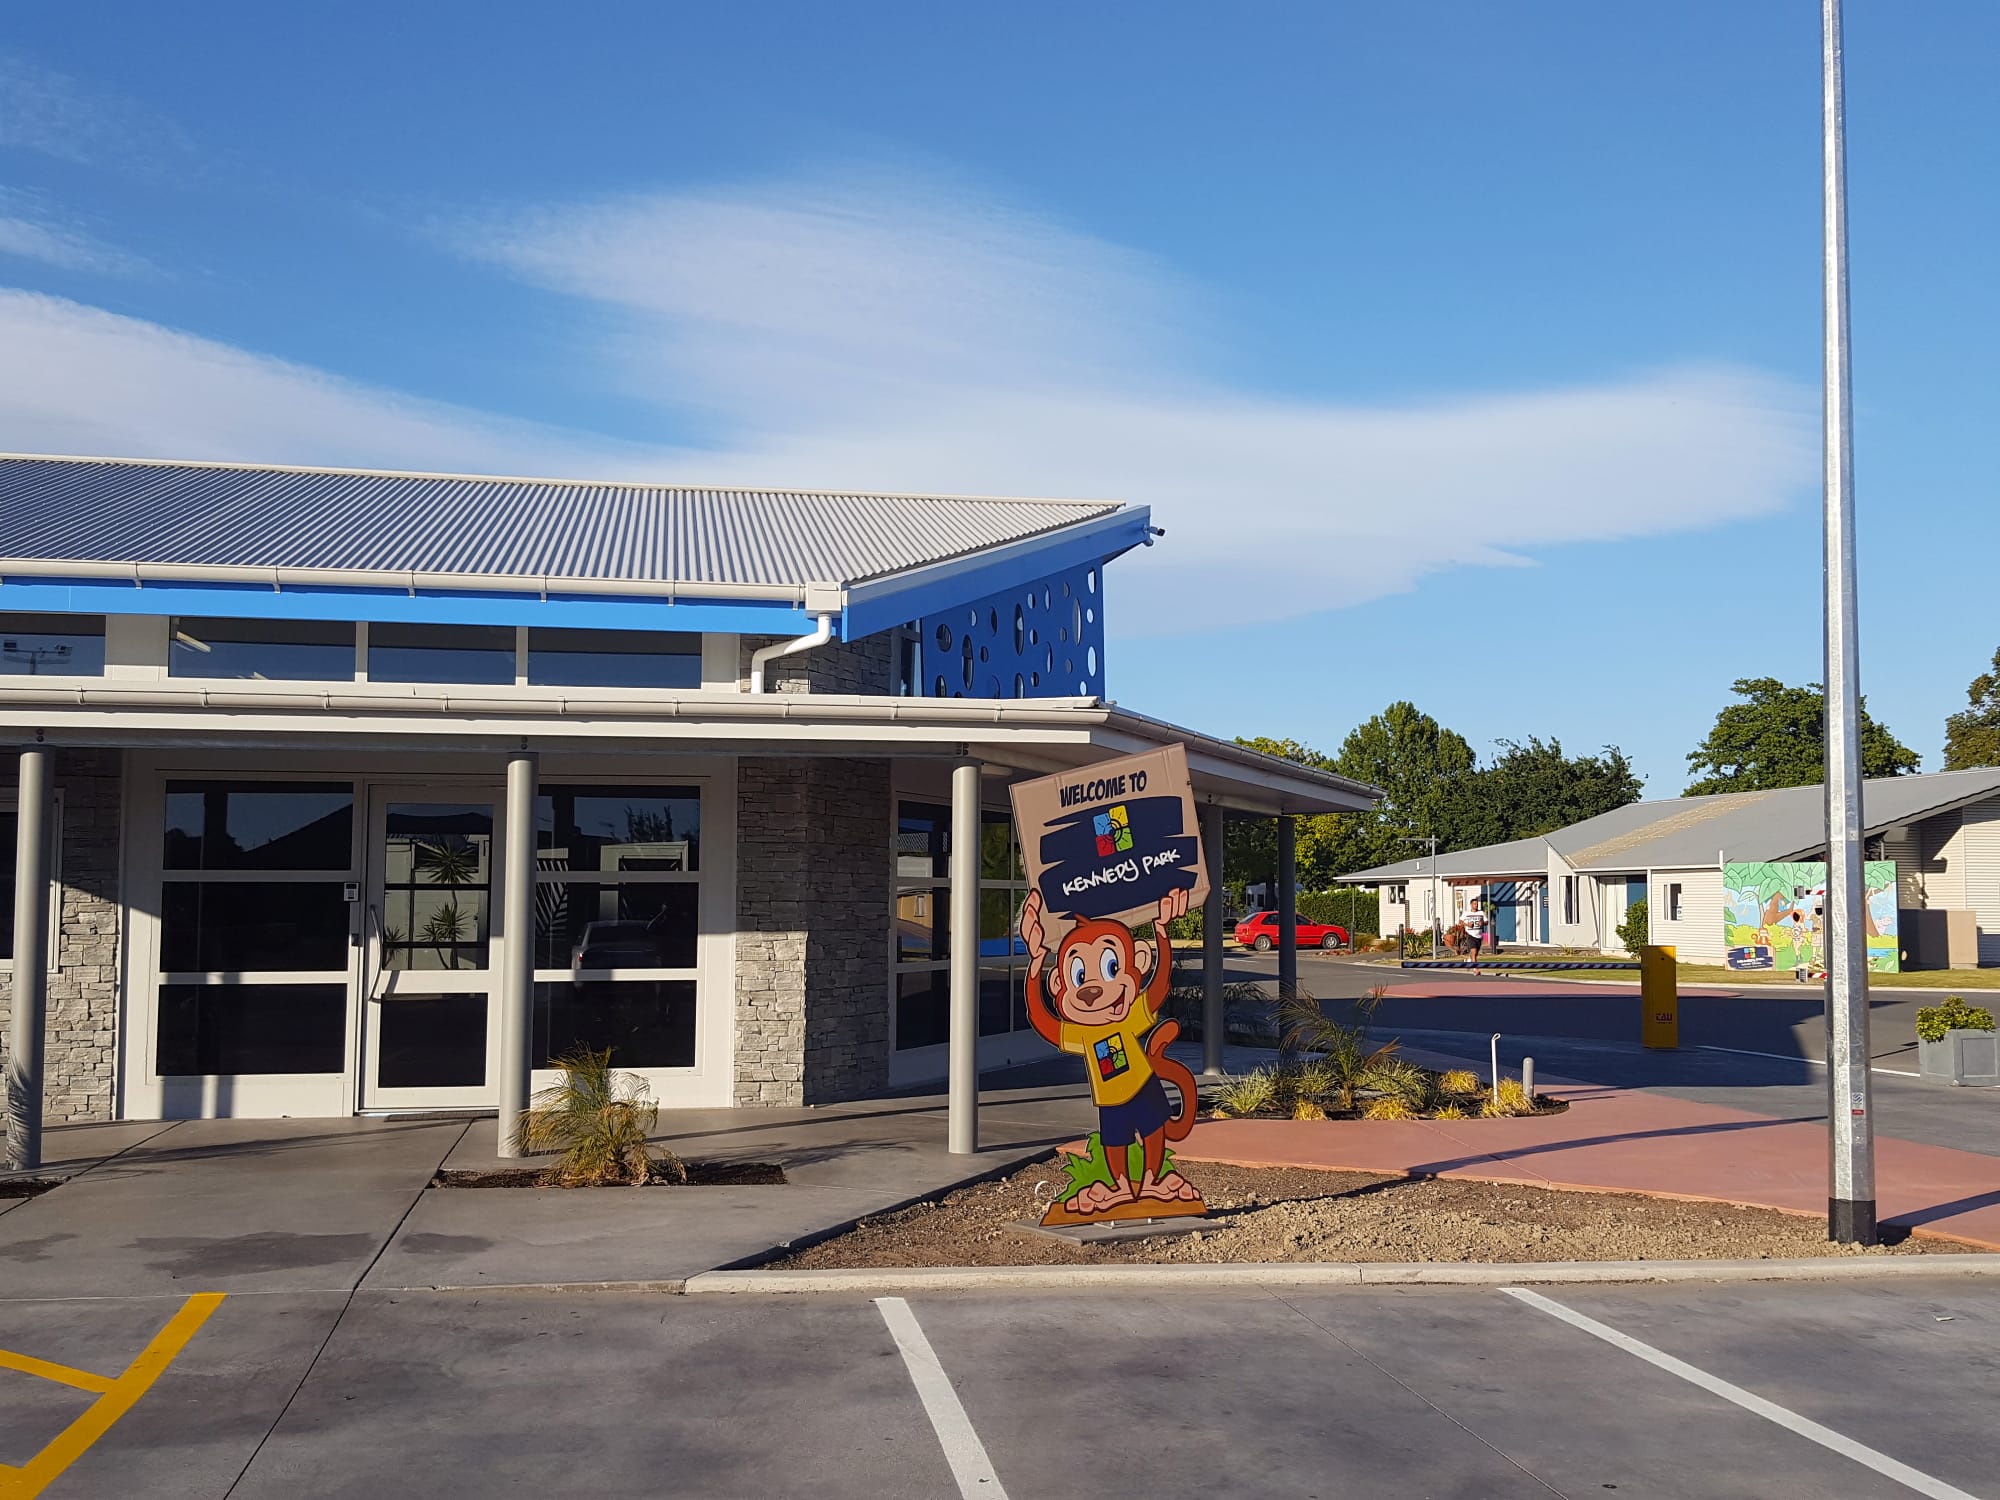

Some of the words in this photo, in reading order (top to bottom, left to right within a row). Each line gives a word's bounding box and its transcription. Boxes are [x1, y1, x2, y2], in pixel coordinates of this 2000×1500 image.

[1060, 775, 1126, 808] WELCOME
[1128, 770, 1147, 792] TO
[1062, 859, 1139, 896] KENNEDY
[1142, 848, 1181, 875] PARK
